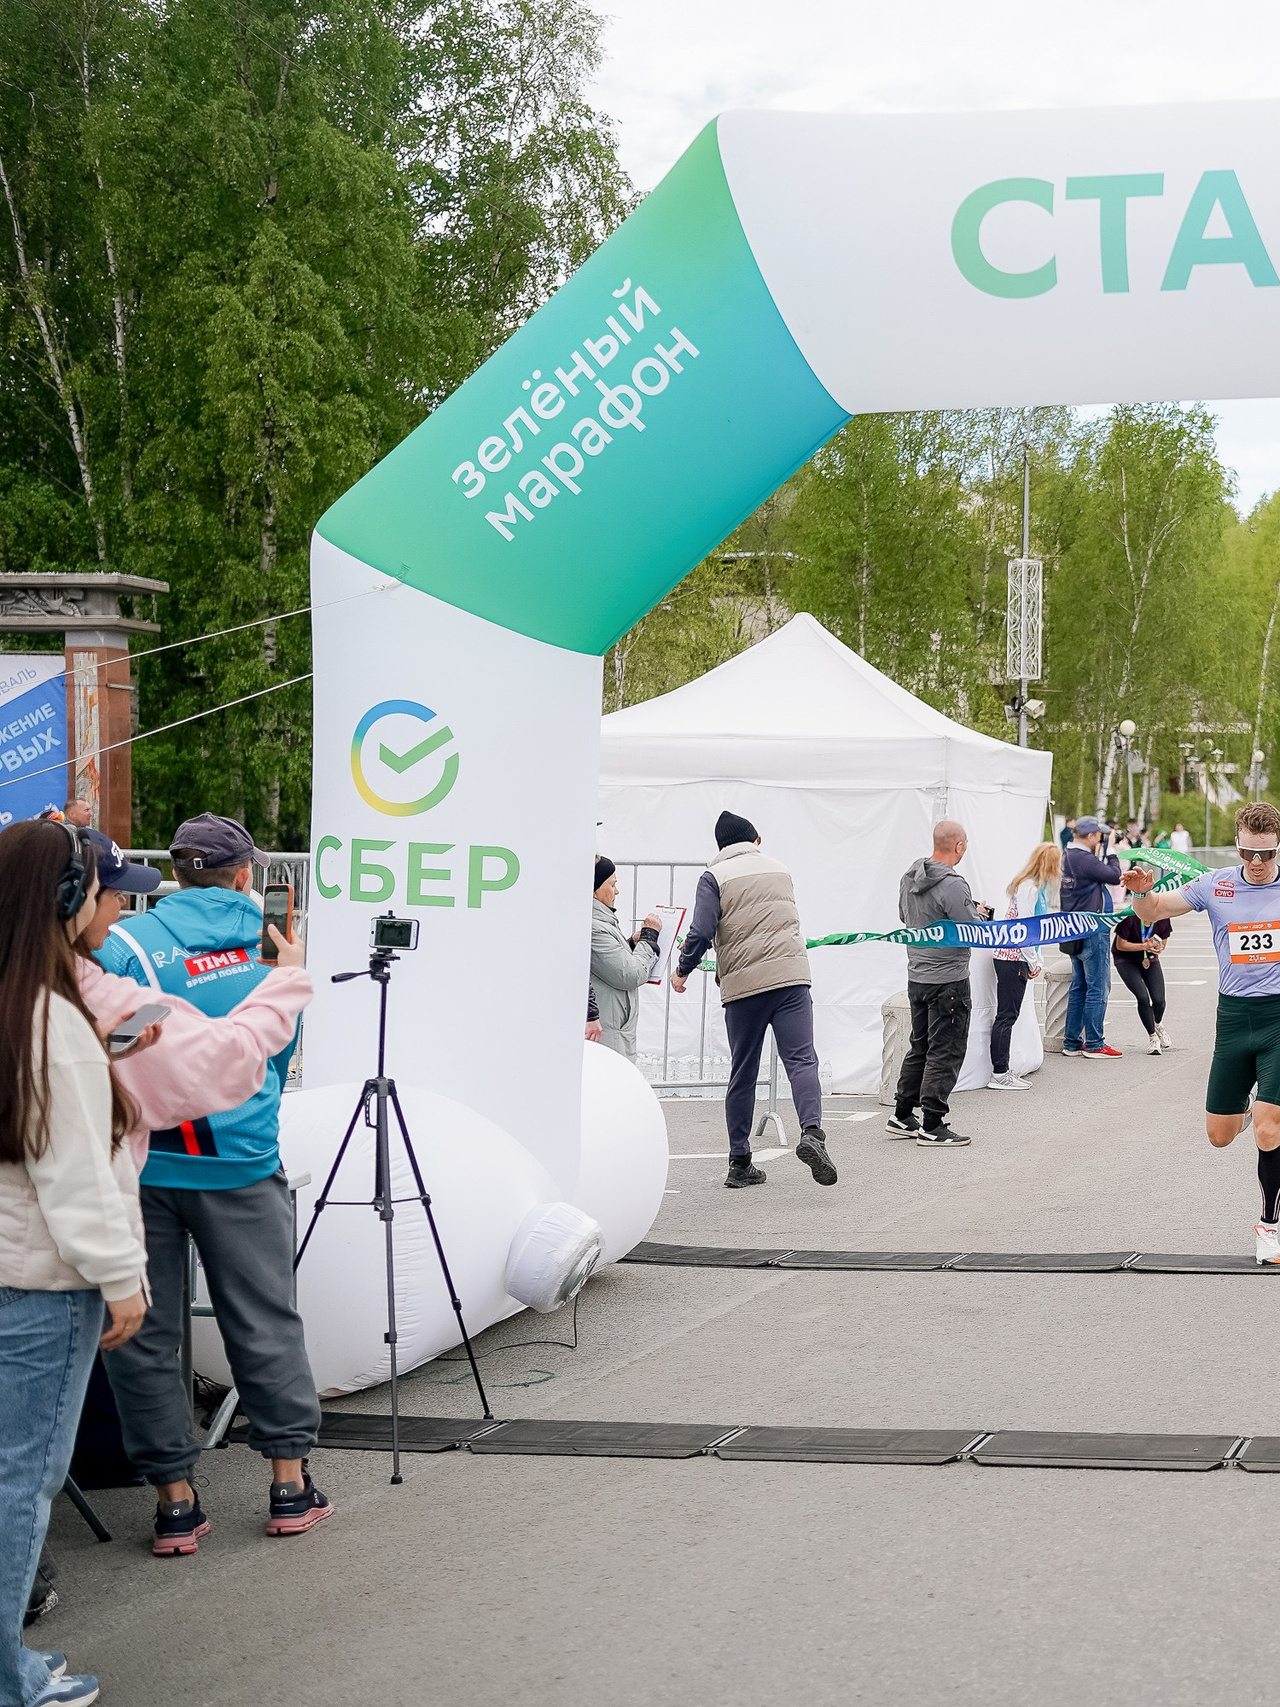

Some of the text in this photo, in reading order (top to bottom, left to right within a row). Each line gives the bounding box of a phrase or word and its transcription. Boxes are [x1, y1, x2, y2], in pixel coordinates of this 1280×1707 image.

[451, 277, 661, 498] зелёный
[484, 327, 700, 542] марафон
[0, 727, 61, 773] ВЫХ
[315, 835, 520, 908] СБЕР
[151, 946, 210, 969] RA
[1240, 933, 1273, 951] 233
[192, 950, 241, 972] TIME
[185, 972, 218, 988] ВРЕМЯ
